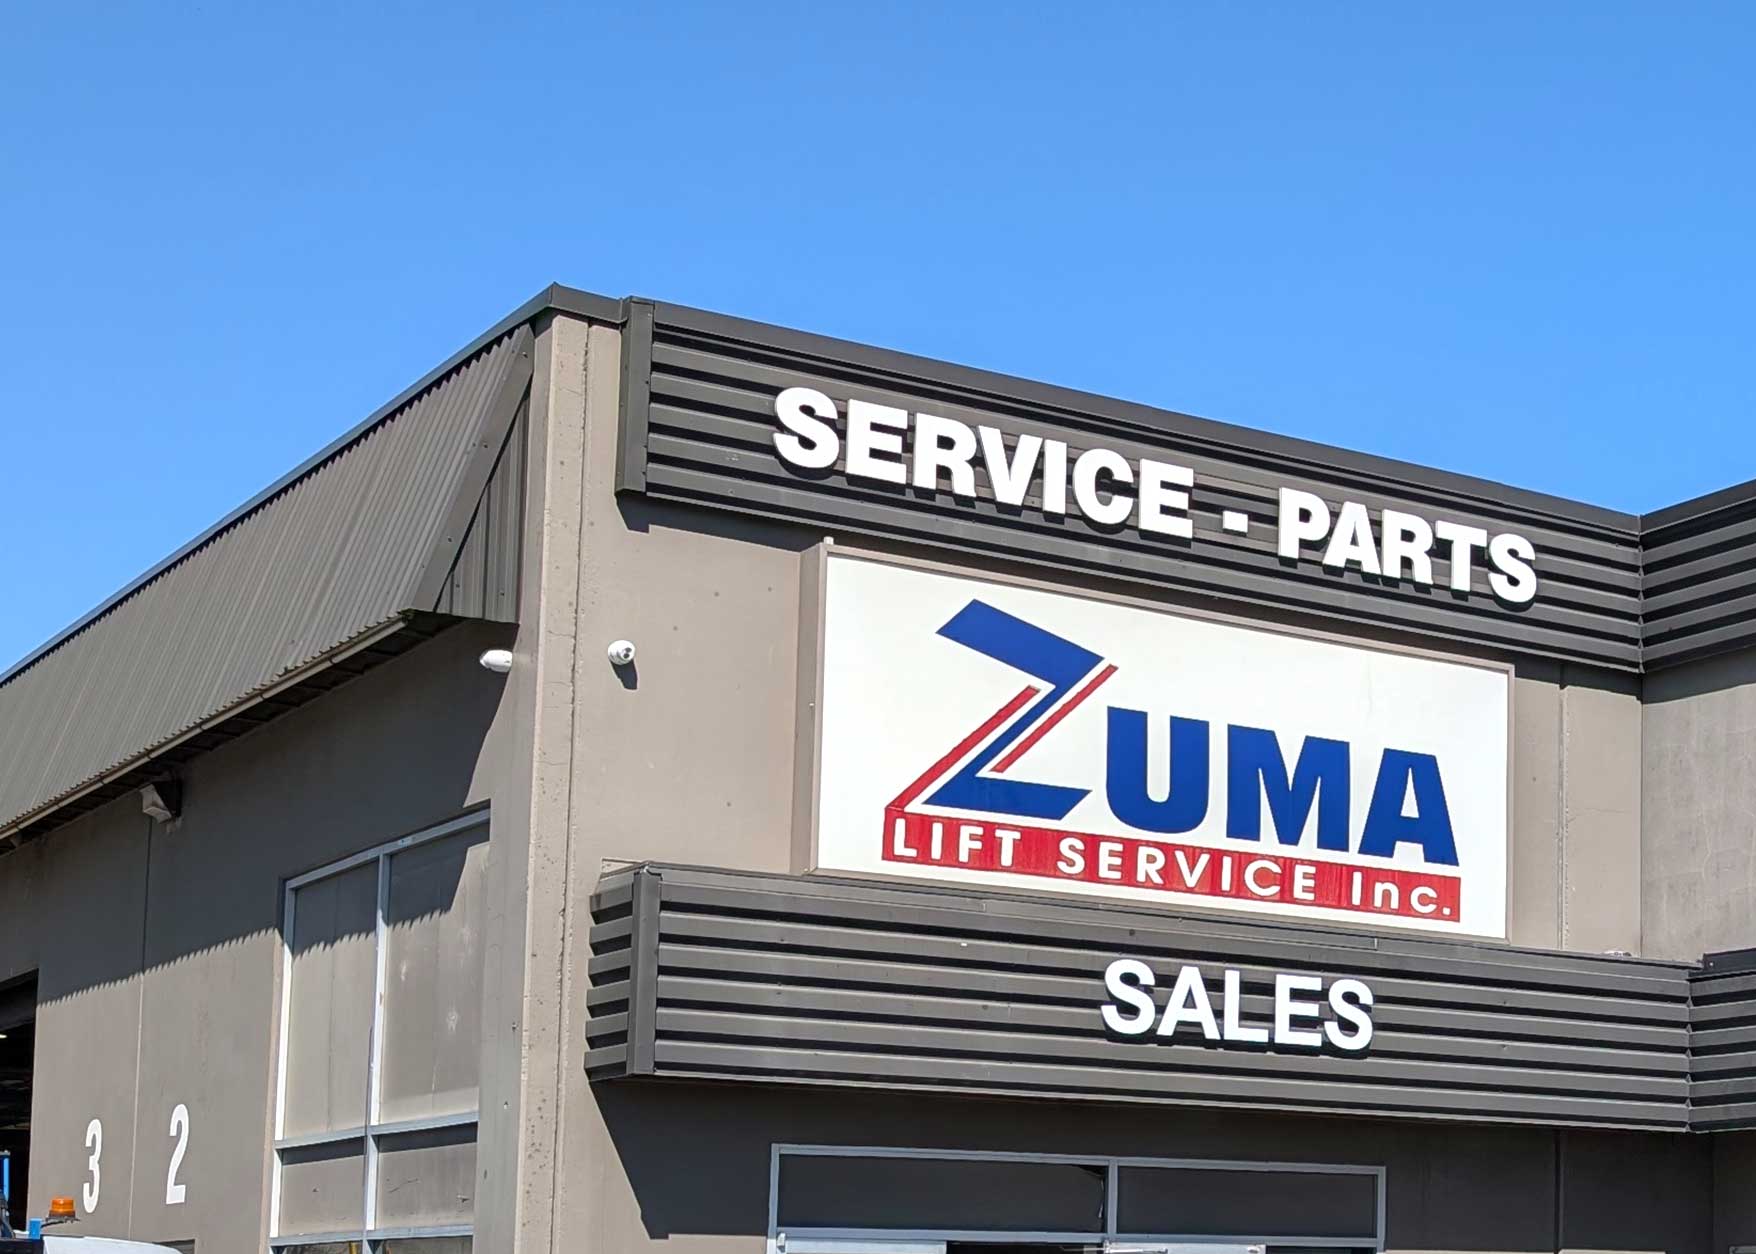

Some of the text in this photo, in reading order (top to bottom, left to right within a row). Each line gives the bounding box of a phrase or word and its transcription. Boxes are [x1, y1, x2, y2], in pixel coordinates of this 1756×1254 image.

[773, 386, 1195, 540] SERVICE
[1277, 486, 1539, 604] PARTS
[886, 598, 1459, 868] ZUMA
[892, 818, 1452, 916] LIFT SERVICE Inc.
[1100, 958, 1374, 1050] SALES
[83, 1118, 102, 1213] 3
[165, 1103, 189, 1205] 2
